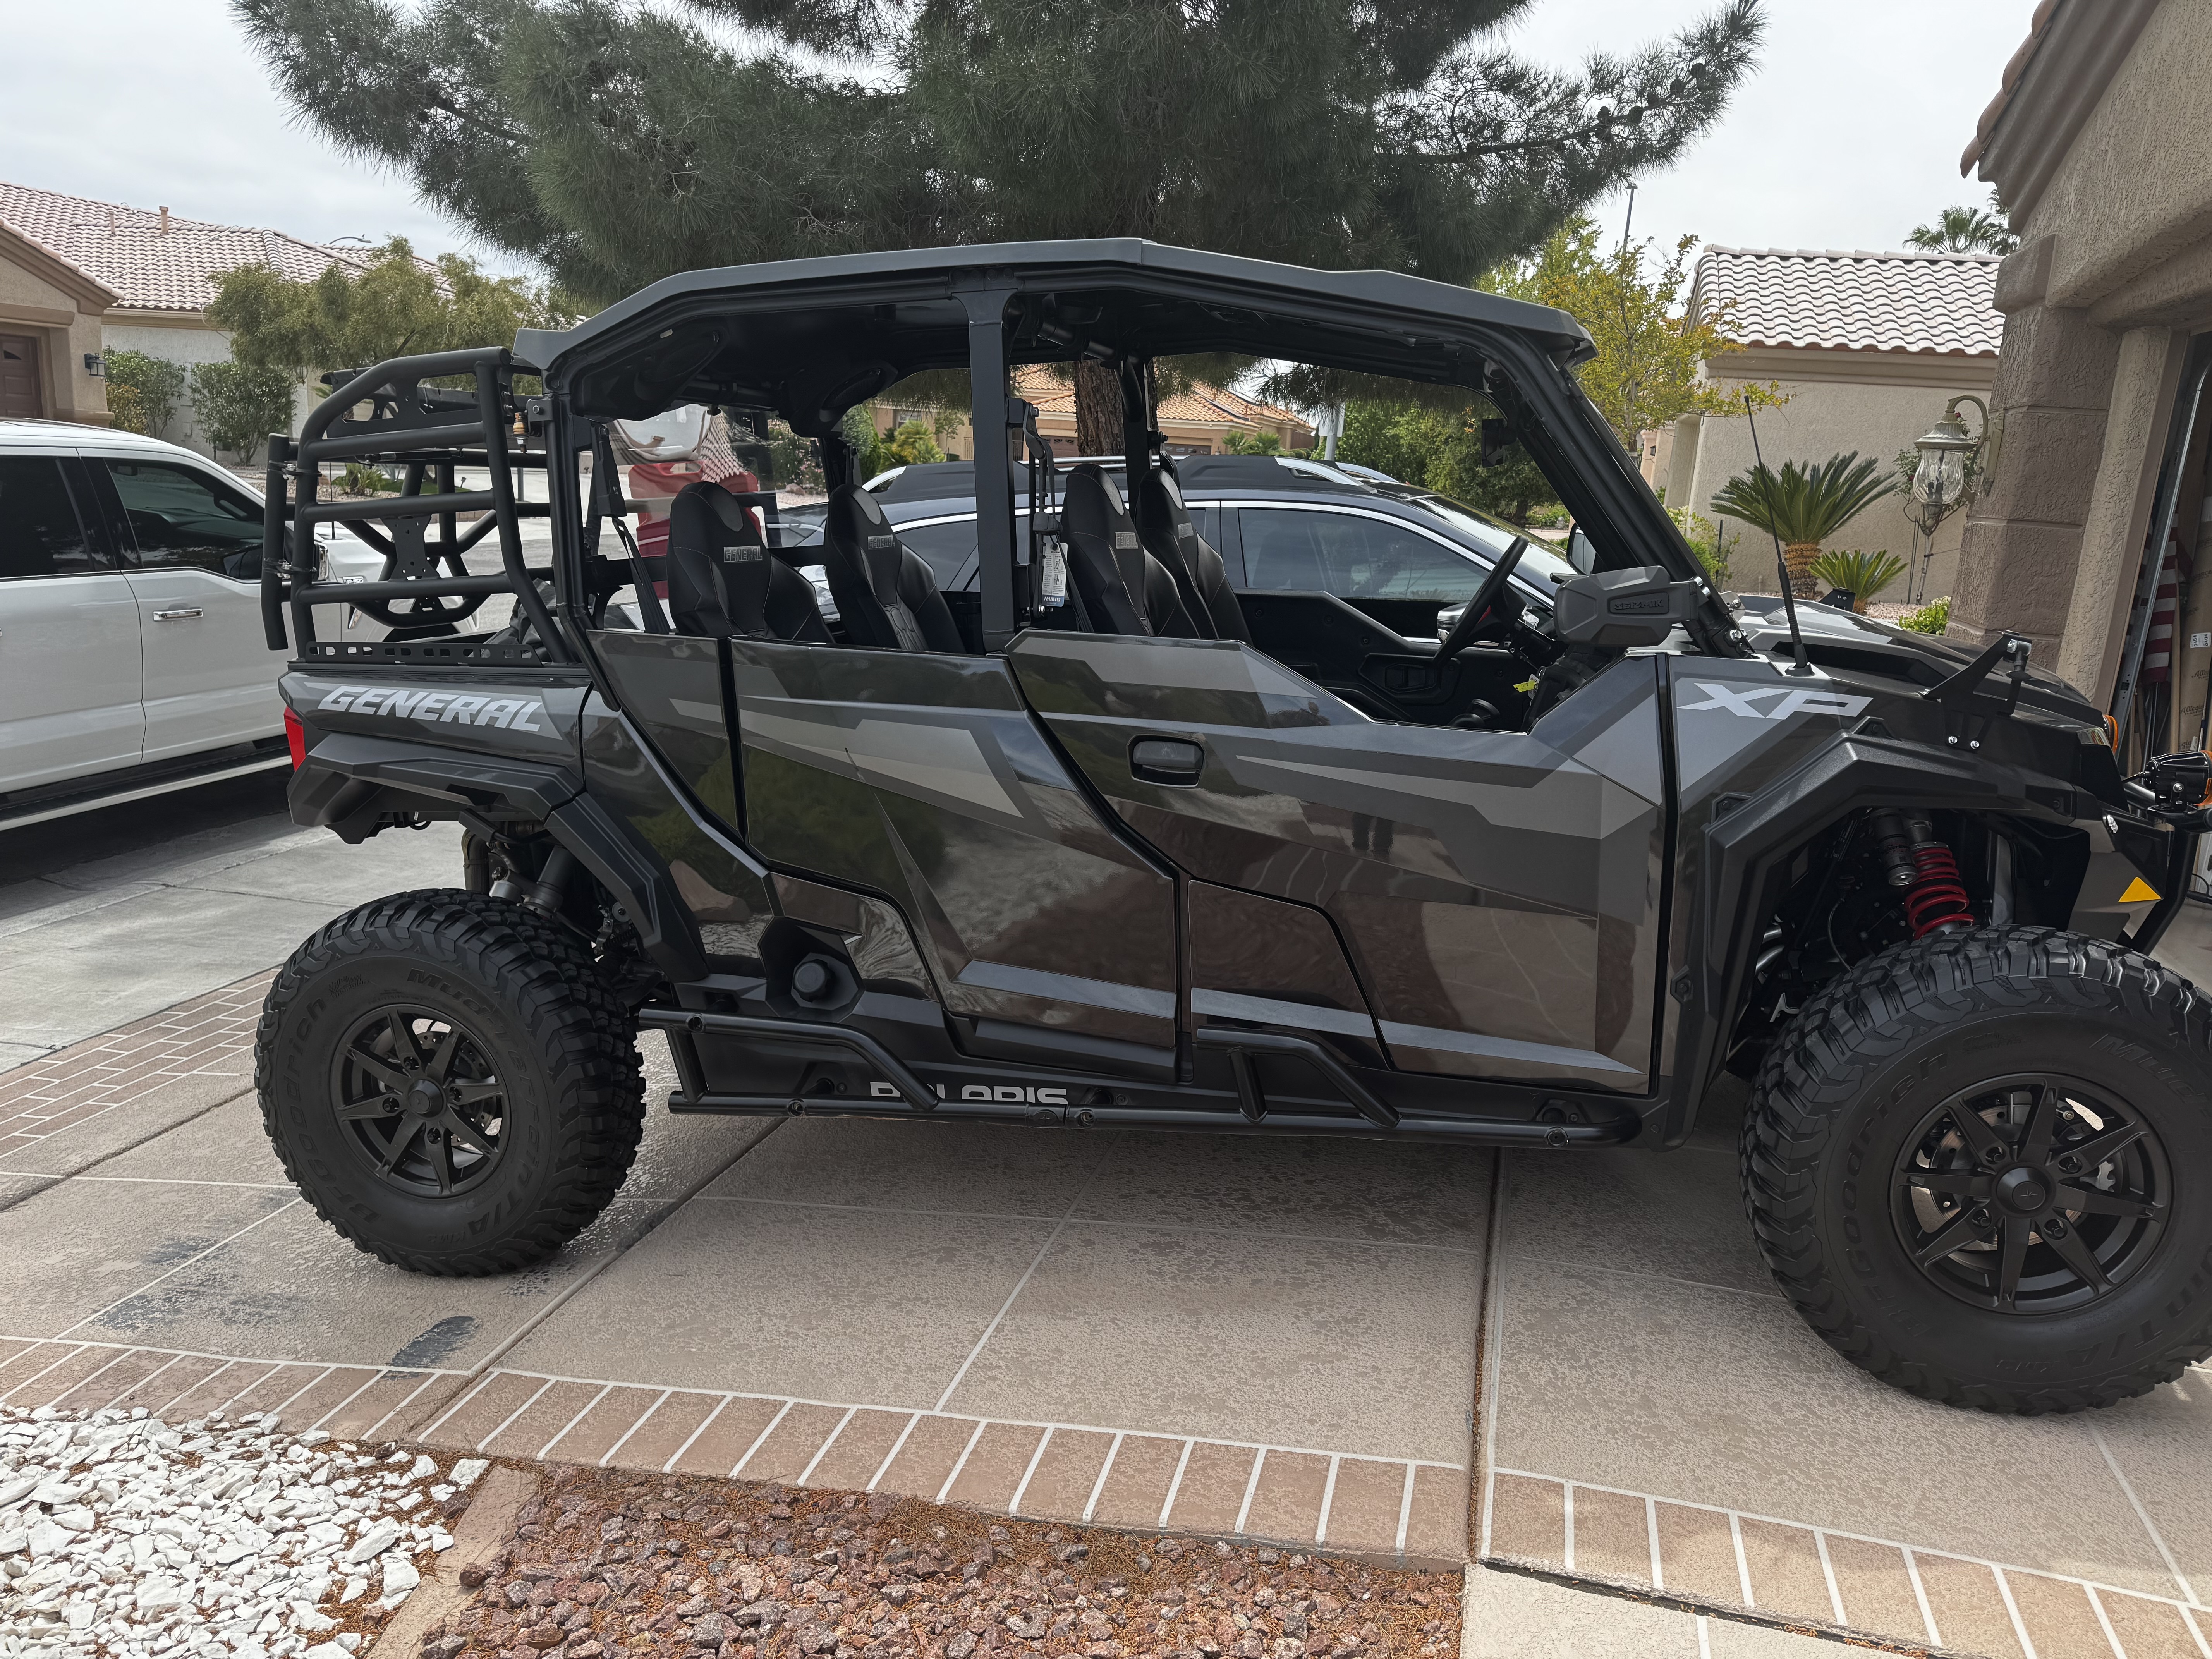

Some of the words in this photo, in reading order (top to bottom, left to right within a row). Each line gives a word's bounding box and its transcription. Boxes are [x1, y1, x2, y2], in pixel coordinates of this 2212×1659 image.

[724, 546, 763, 562] GENERAL
[868, 536, 895, 549] GENERAL
[1614, 599, 1664, 610] SEIZMIK
[318, 685, 542, 732] GENERAL
[1676, 683, 1874, 720] XP
[283, 997, 382, 1221] BFGoodrich
[1842, 1053, 1949, 1338] BFGoodrich
